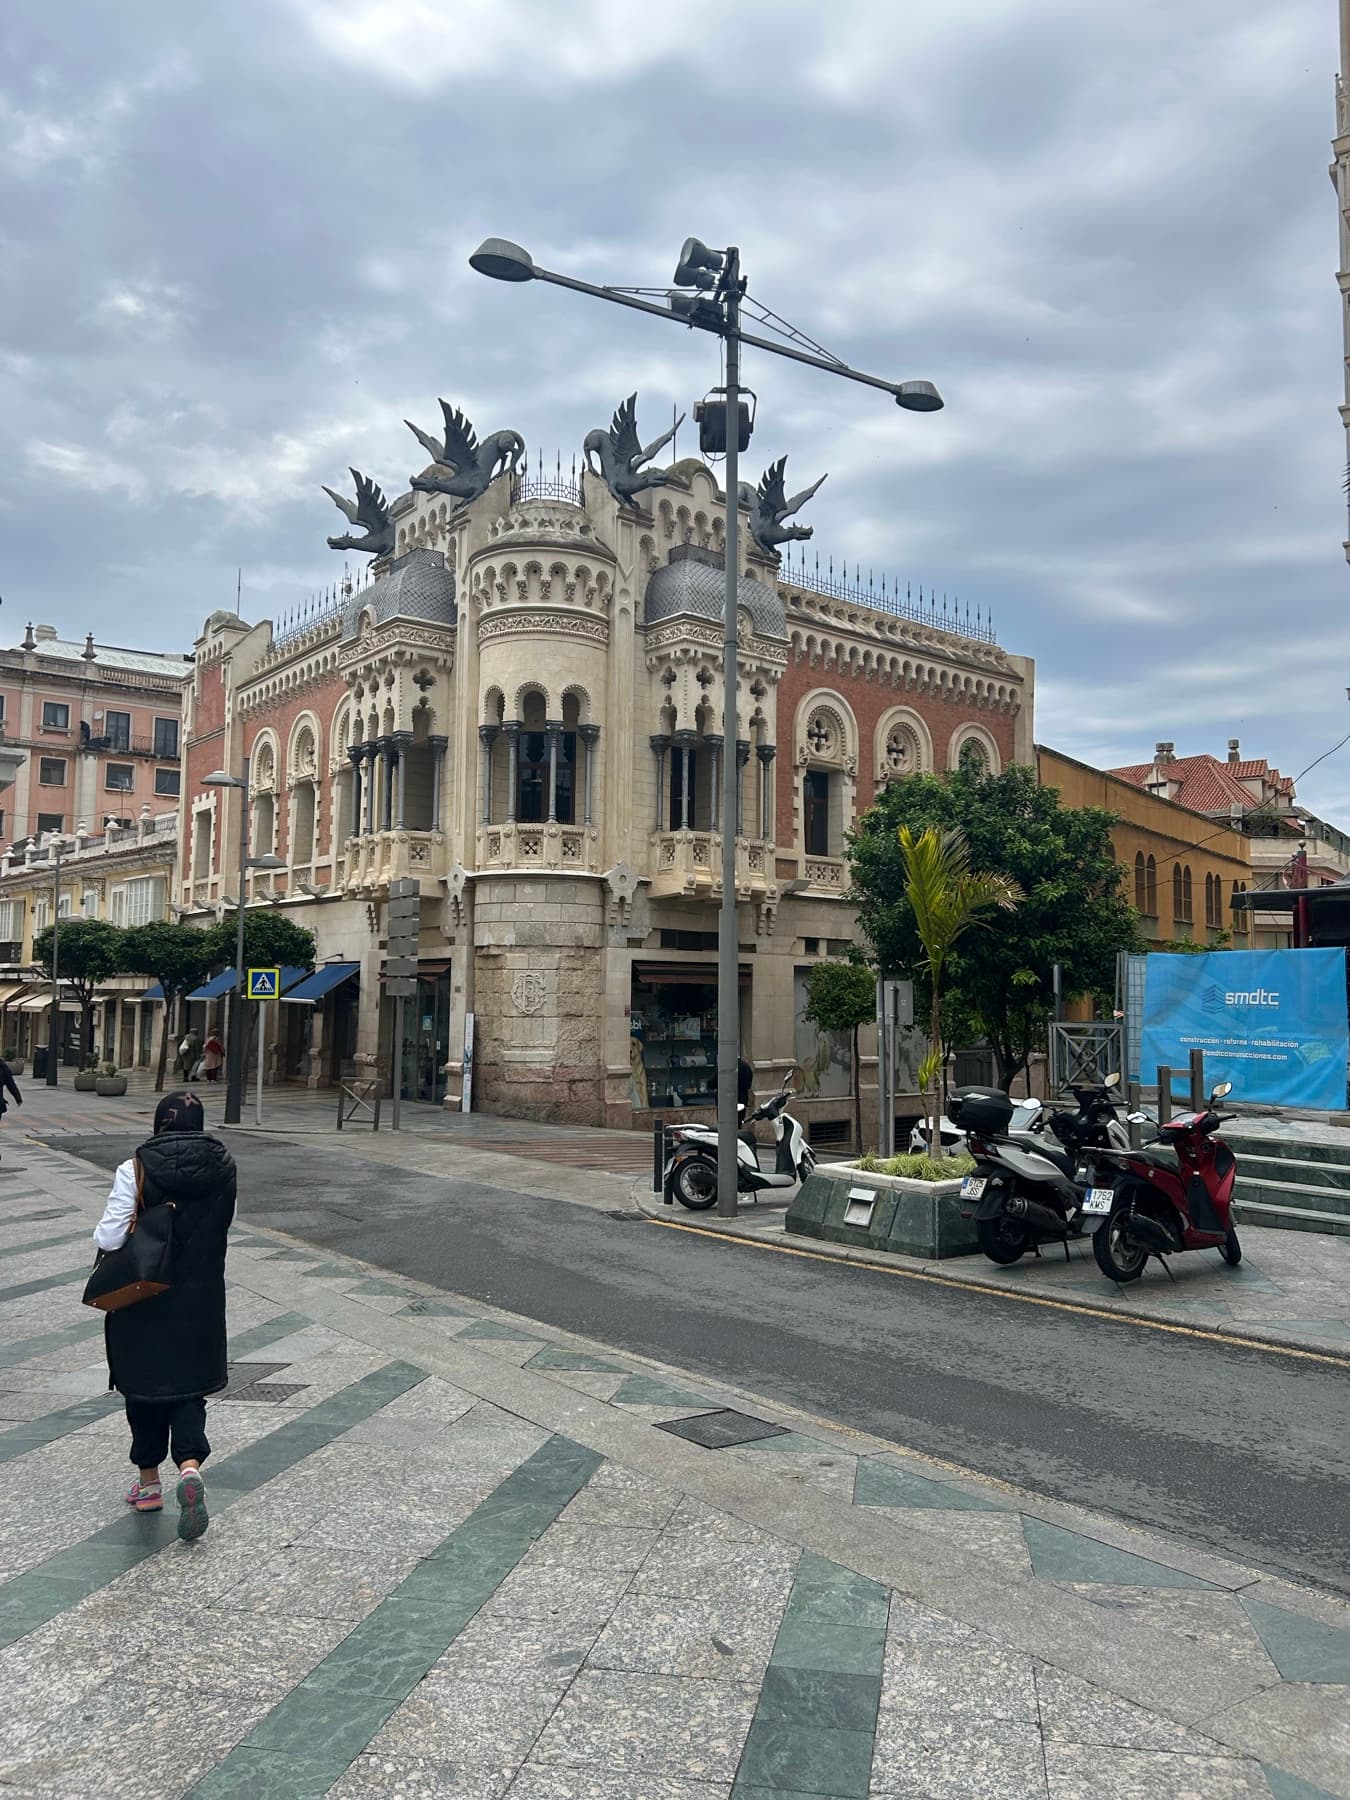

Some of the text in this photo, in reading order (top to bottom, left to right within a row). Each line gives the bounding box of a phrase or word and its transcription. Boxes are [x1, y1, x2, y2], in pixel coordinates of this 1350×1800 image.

[1225, 988, 1280, 1005] smdtc
[1251, 1039, 1299, 1049] rehabilitación
[1093, 1190, 1113, 1201] 1752
[1089, 1200, 1105, 1210] KMS
